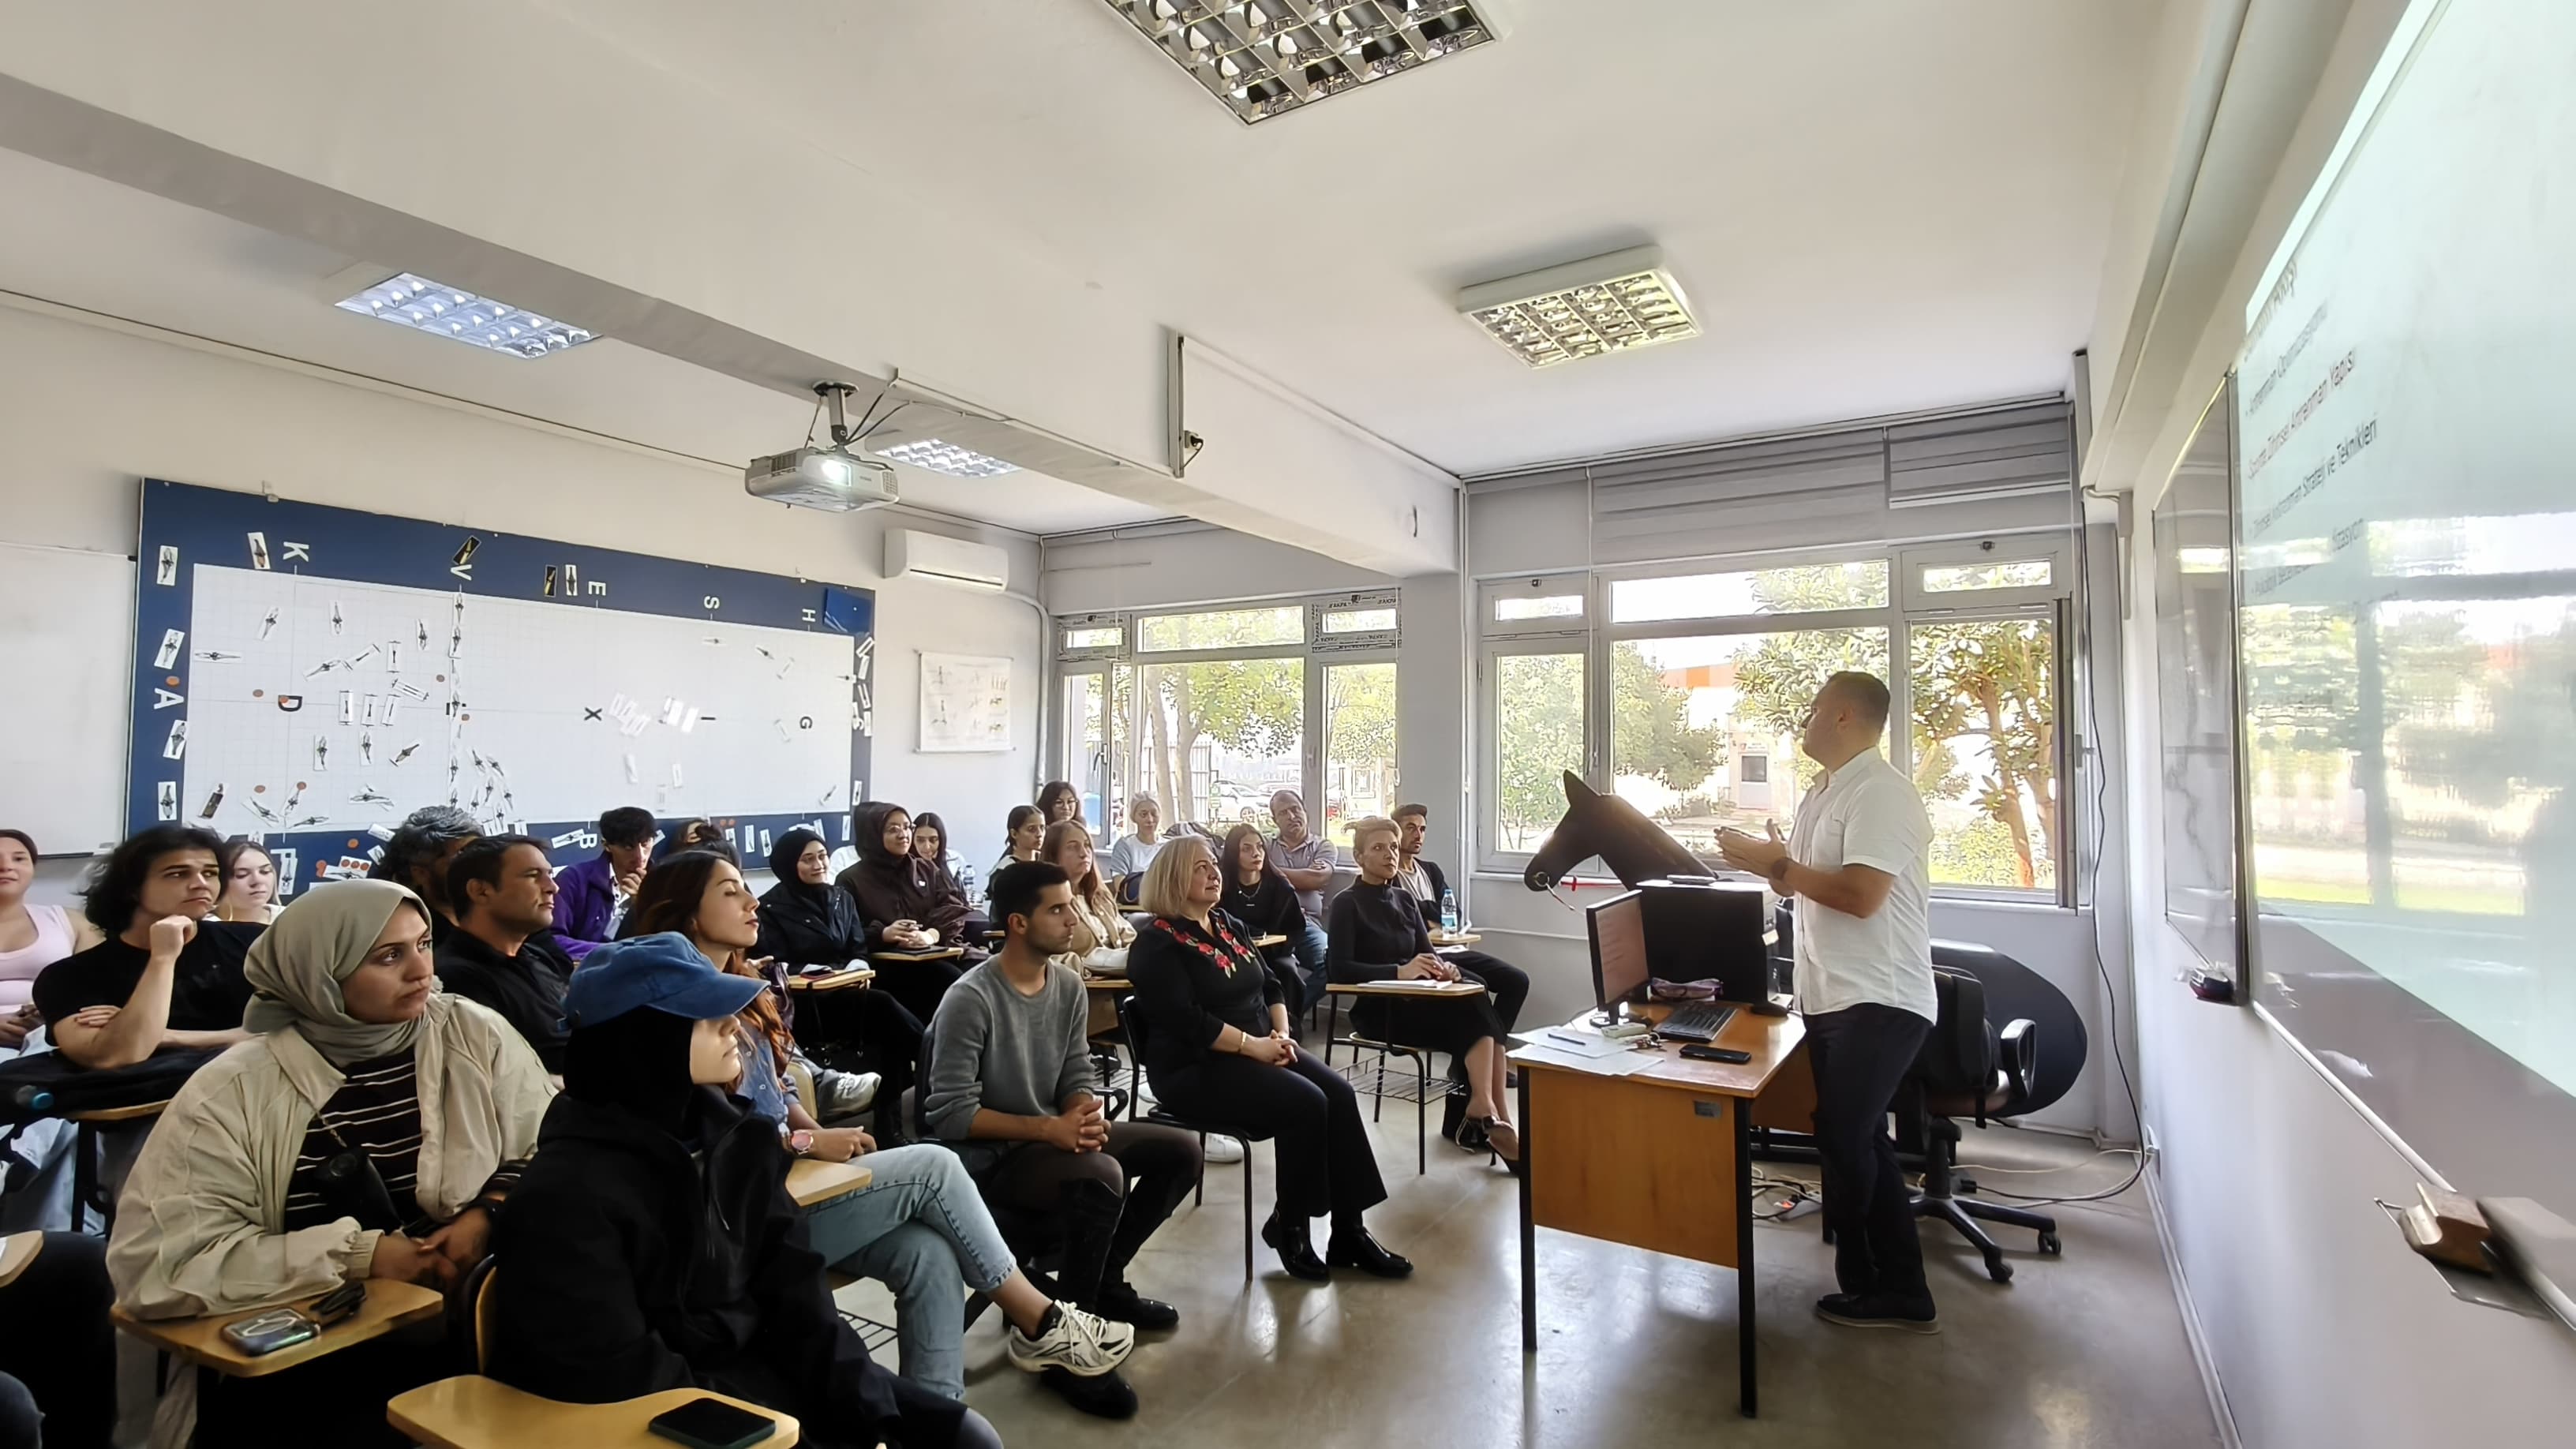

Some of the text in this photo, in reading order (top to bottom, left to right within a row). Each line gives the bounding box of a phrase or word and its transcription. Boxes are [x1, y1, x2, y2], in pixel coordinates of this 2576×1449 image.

[283, 541, 310, 562] K
[450, 564, 473, 582] V
[587, 581, 607, 597] E
[703, 596, 720, 610] S
[801, 608, 816, 623] H
[153, 687, 185, 710] A
[277, 695, 303, 713] D
[584, 706, 603, 722] X
[799, 716, 814, 730] G
[579, 833, 597, 849] B
